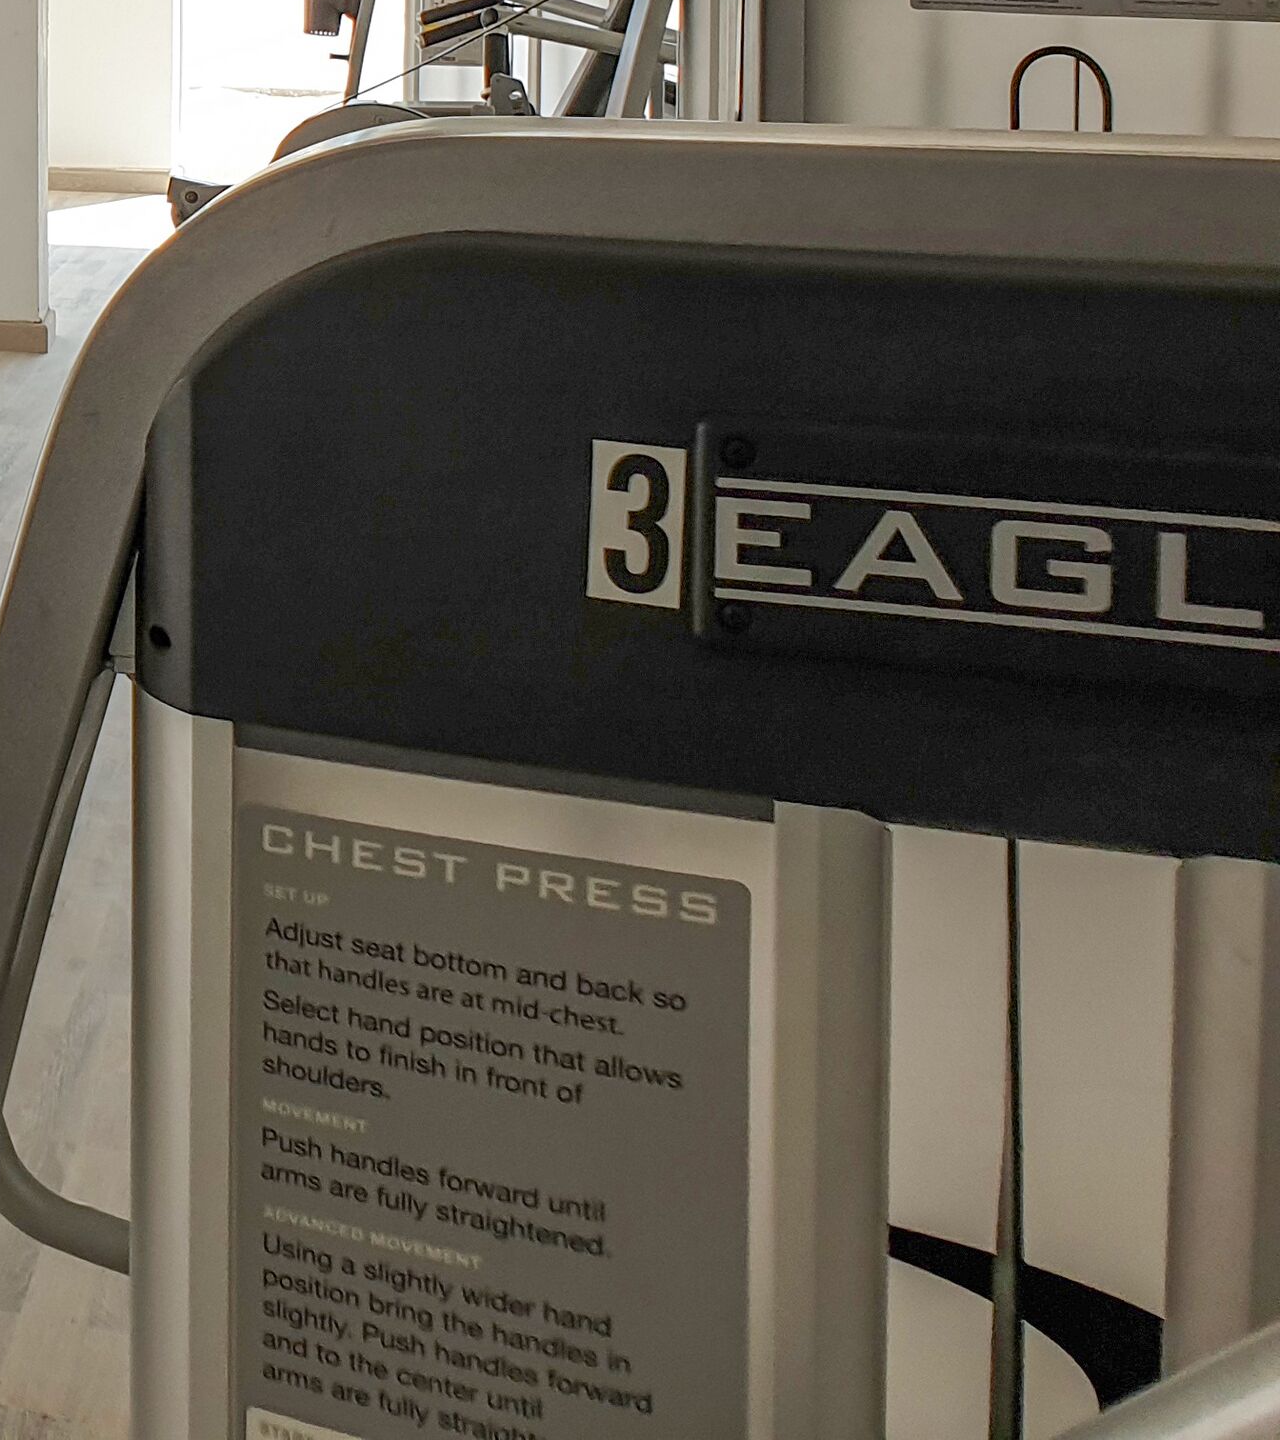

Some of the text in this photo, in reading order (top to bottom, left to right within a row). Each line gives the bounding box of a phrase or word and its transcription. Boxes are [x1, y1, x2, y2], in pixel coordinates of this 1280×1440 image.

[603, 453, 670, 593] 3
[261, 823, 719, 927] CHEST PRESS
[262, 884, 330, 908] SET UP
[264, 917, 687, 1012] Adjust seat bottom and back so
[265, 951, 624, 1036] that handles are at mid-chest.
[262, 1055, 391, 1100] shoulders.
[263, 989, 684, 1090] Select hand position that allows
[263, 1021, 585, 1105] hands to finish in front of
[261, 1096, 370, 1134] MOVEMENT
[260, 1162, 611, 1259] arms are fully straightened.
[261, 1126, 607, 1223] Push handles forward until
[263, 1204, 482, 1271] ADVANCED MOVEMENT
[262, 1232, 614, 1339] Using a slightly wider hand
[262, 1267, 633, 1375] position bring the handles in
[262, 1297, 655, 1417] slightly. Push handles forward
[262, 1330, 544, 1421] and to the center until
[262, 1362, 324, 1395] arms
[331, 1382, 372, 1408] are
[378, 1390, 430, 1429] fully
